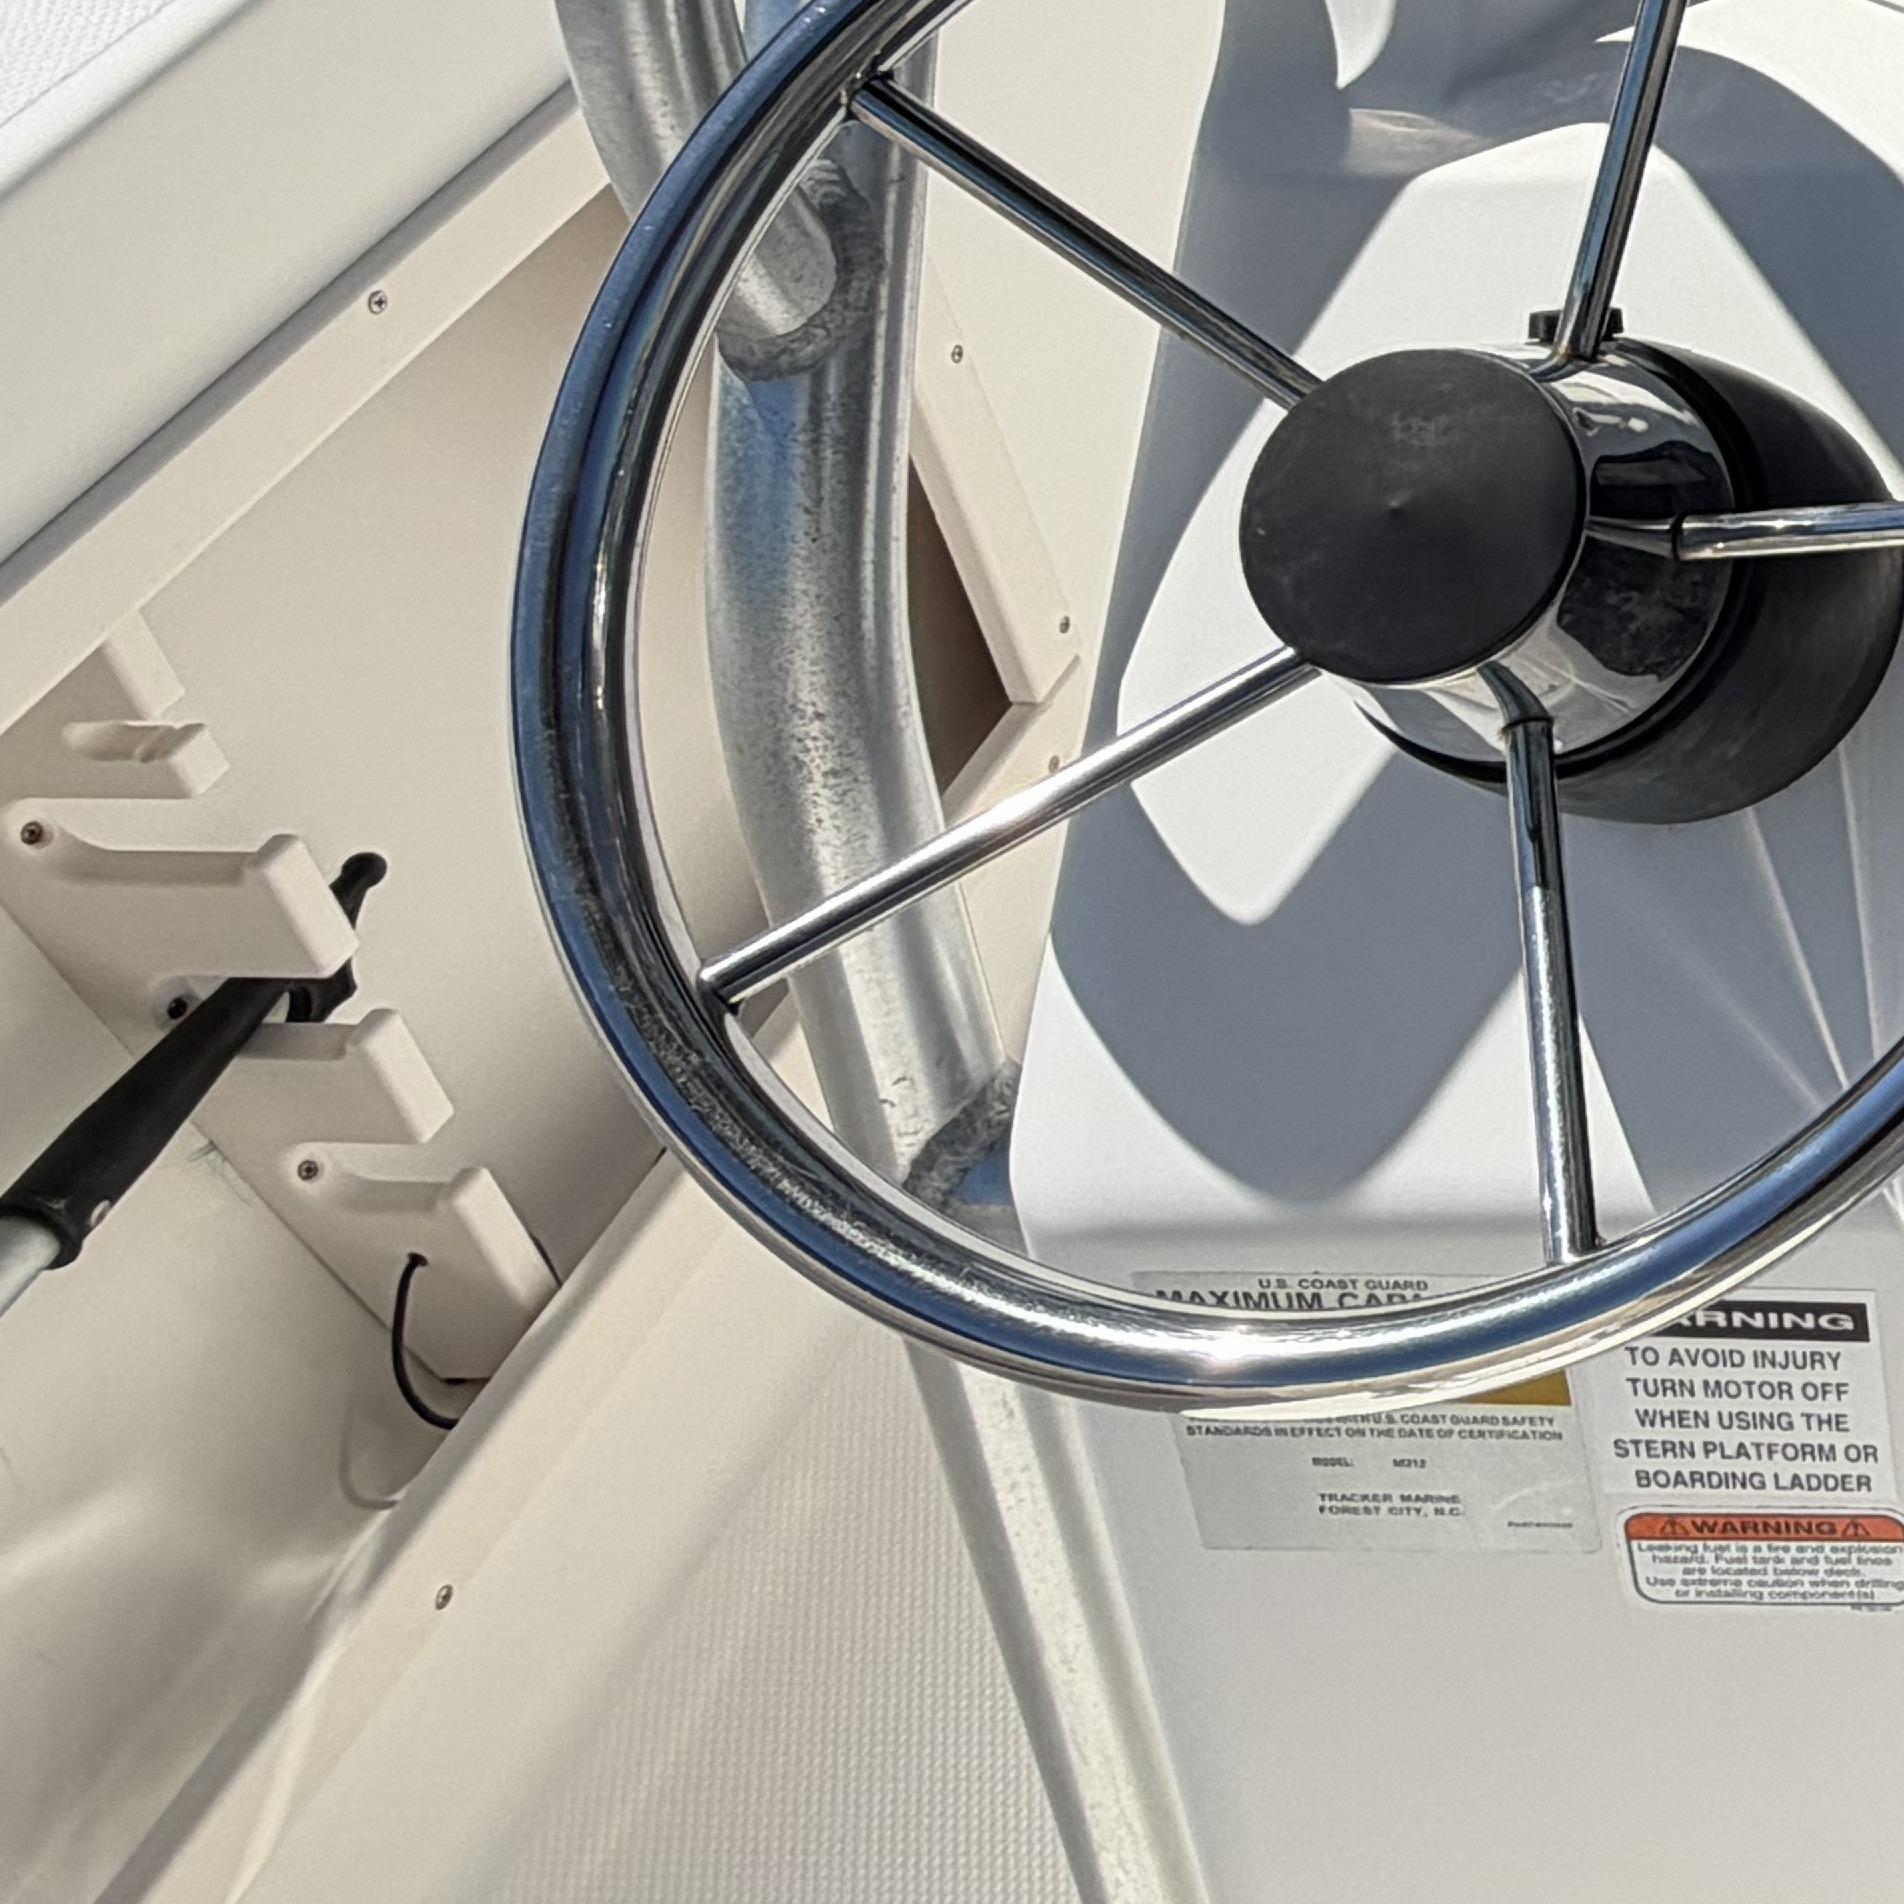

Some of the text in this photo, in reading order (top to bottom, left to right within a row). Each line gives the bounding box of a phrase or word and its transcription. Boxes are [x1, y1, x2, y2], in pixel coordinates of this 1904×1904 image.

[1298, 1278, 1359, 1290] COAST
[1364, 1280, 1428, 1291] GUARD
[1676, 1309, 1856, 1332] RNING
[1624, 1346, 1842, 1372] TO AVOID INJURY
[1625, 1378, 1850, 1403] TURN MOTOR OFF
[1634, 1408, 1851, 1434] WHEN USING THE
[1612, 1438, 1880, 1464] STERN PLATFORM OR
[1635, 1469, 1873, 1493] BOARDING LADDER
[1318, 1493, 1394, 1503] TRACKER
[1690, 1518, 1838, 1537] WARNING
